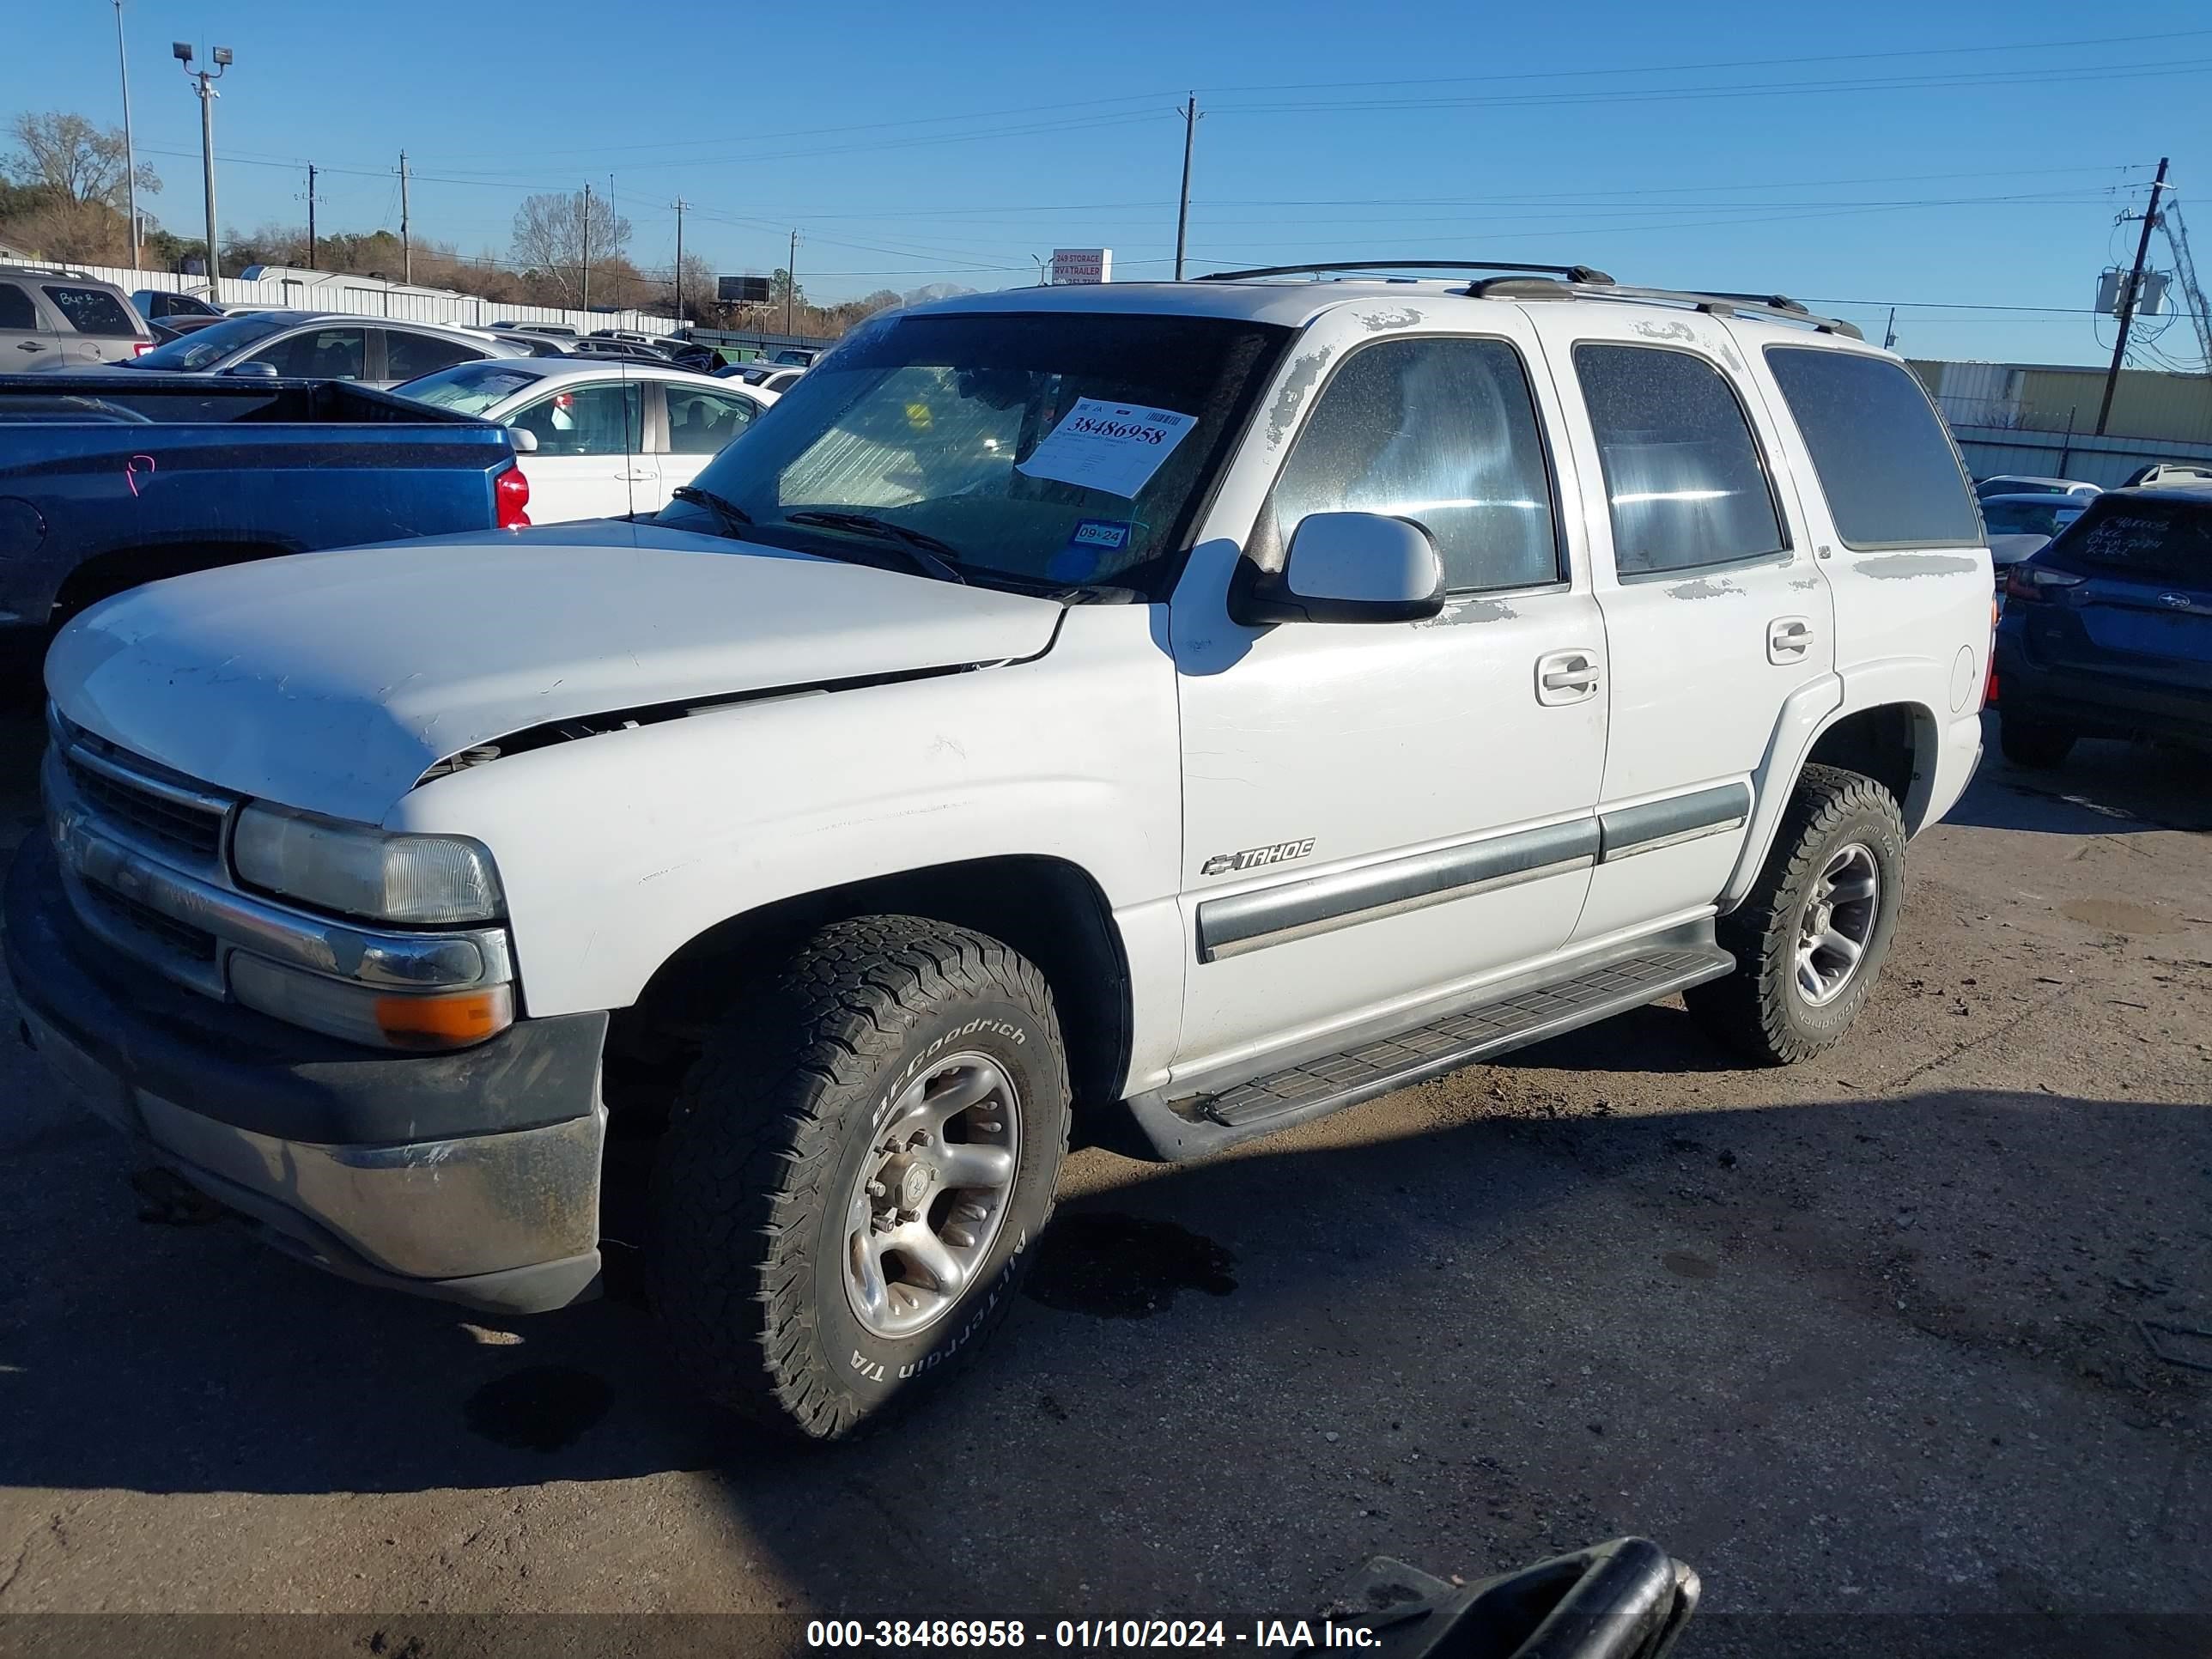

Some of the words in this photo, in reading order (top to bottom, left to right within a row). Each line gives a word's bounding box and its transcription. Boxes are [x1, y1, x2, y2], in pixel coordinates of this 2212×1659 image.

[1069, 254, 1100, 263] STORAGE
[1069, 267, 1100, 276] TRAILER
[1067, 416, 1167, 445] 38486958
[1238, 836, 1316, 870] TAHOE
[872, 1018, 1027, 1129] BFGoodrich
[849, 1349, 885, 1382] T/A
